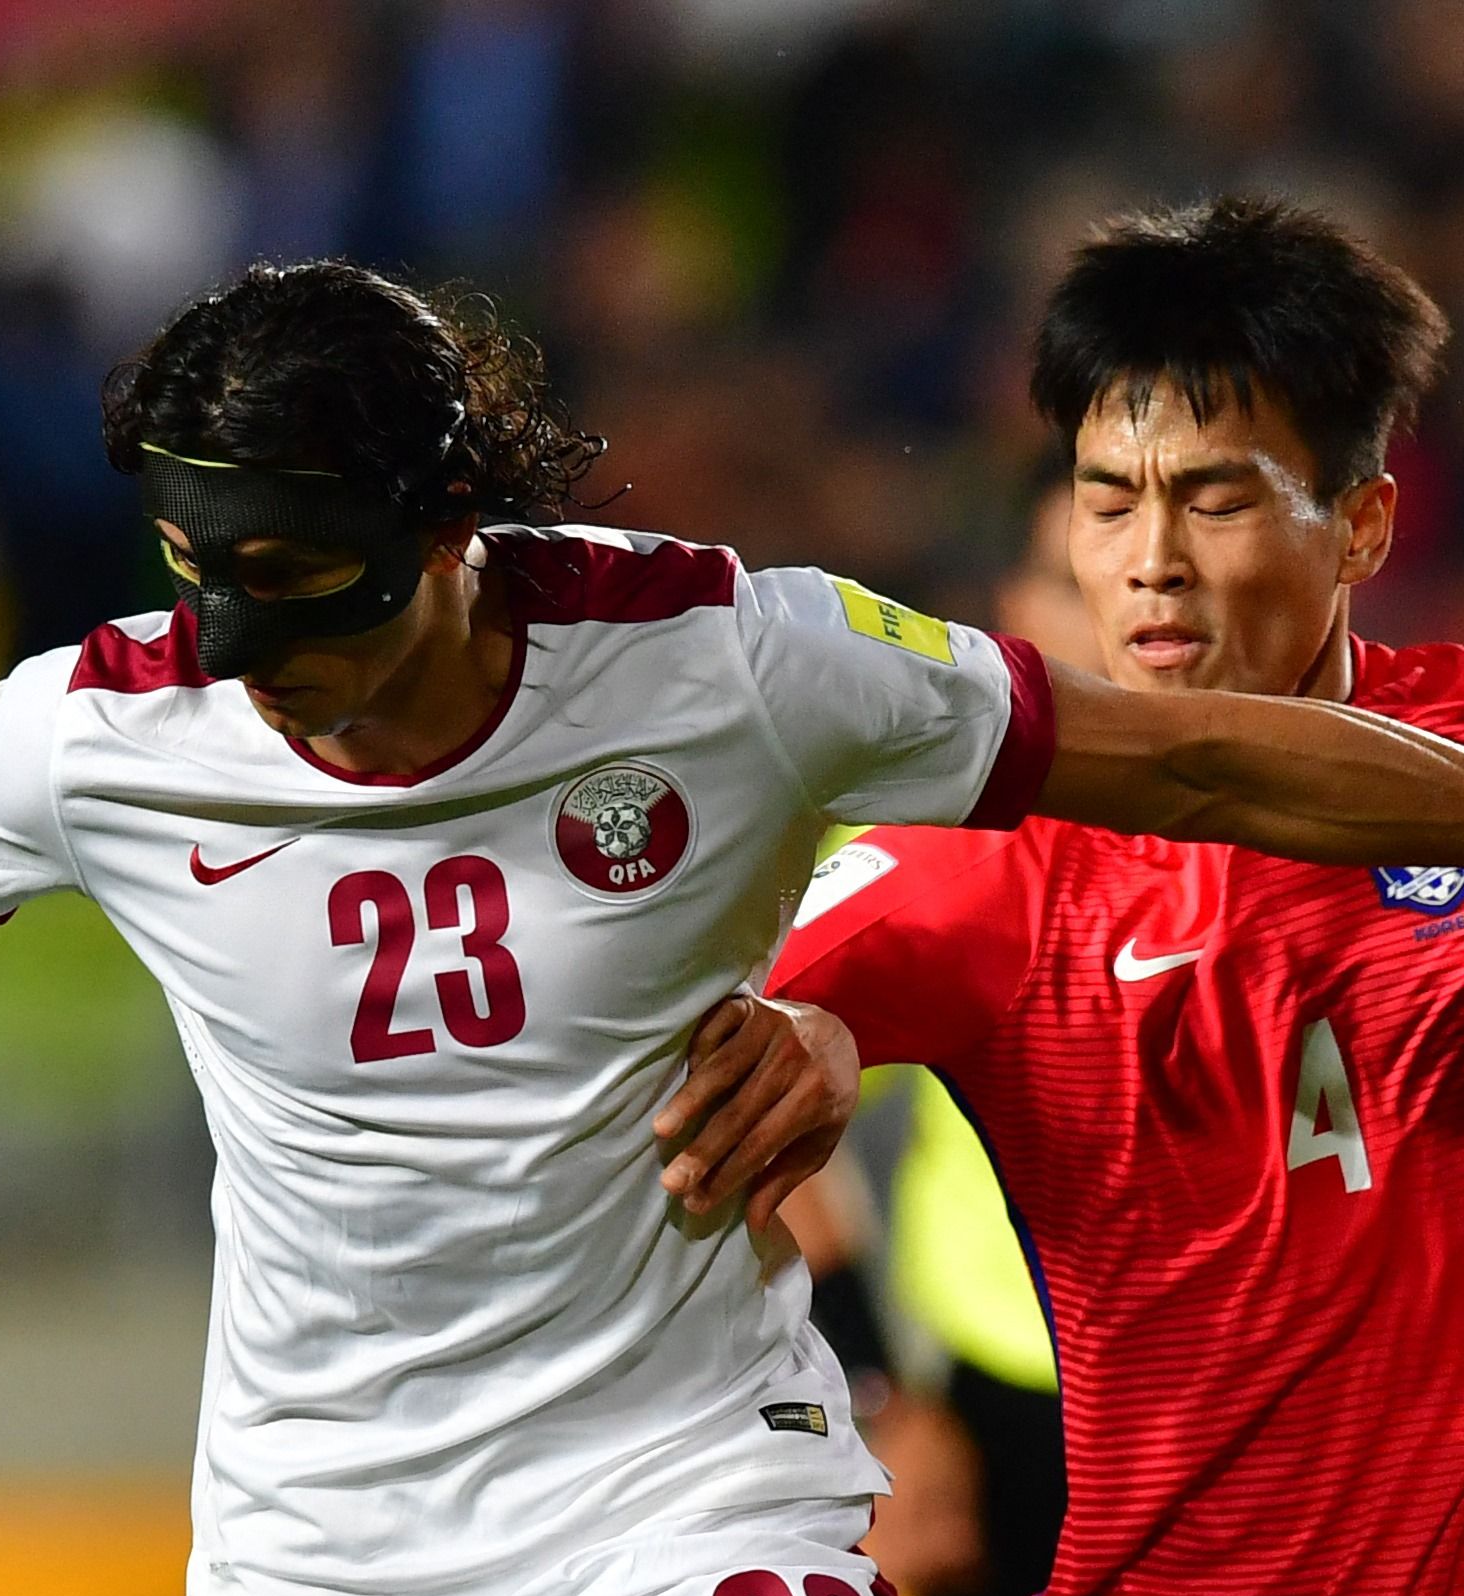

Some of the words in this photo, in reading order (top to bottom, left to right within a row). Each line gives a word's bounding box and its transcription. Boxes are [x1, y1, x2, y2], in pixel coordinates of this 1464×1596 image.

[327, 854, 526, 1063] 23
[608, 858, 657, 885] QFA
[1286, 1016, 1373, 1194] 4
